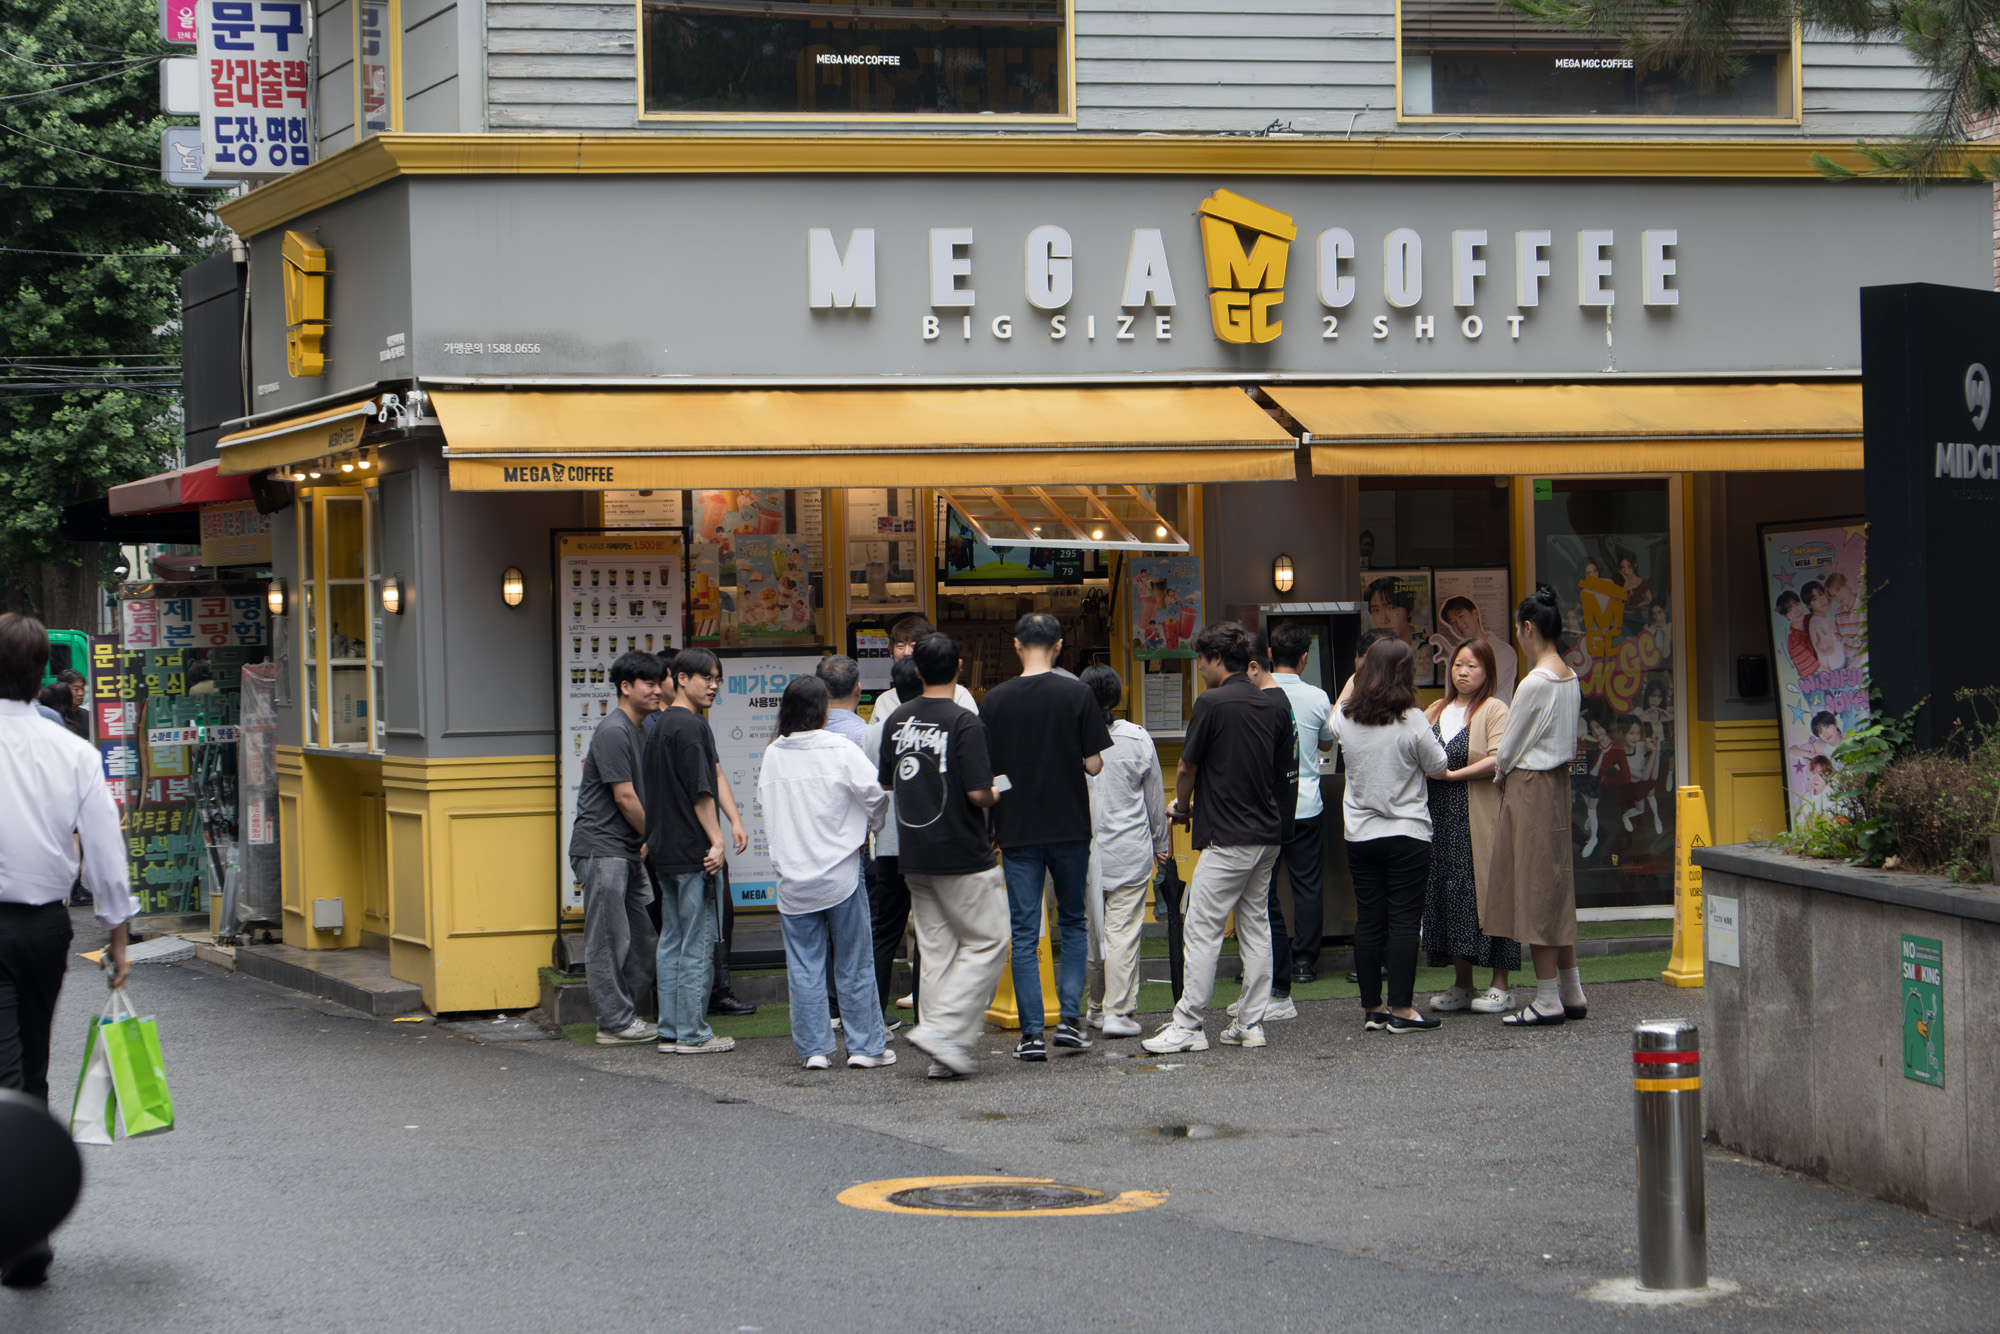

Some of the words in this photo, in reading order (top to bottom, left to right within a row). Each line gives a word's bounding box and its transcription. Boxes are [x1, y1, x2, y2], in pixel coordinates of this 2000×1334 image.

[212, 2, 303, 51] 문구
[816, 54, 843, 64] MEGA
[844, 54, 865, 65] MGC
[865, 55, 900, 66] COFFEE
[1555, 58, 1581, 68] MEGA
[1581, 58, 1600, 68] MGC
[1601, 58, 1634, 69] COFFEE
[211, 59, 306, 109] 칼라출력
[808, 224, 1176, 310] MEGA
[1316, 227, 1679, 308] COFFEE
[443, 343, 484, 354] 가맹문의
[486, 343, 541, 354] 1588.0656
[1935, 442, 2000, 479] MIDCI
[504, 467, 550, 482] MEGA
[569, 467, 613, 482] COFFEE
[1060, 549, 1077, 558] 295
[1794, 558, 1811, 567] MEGA
[1062, 567, 1074, 576] 79
[728, 674, 804, 695] 메가오
[150, 730, 180, 742] 스마트폰
[182, 729, 198, 741] 출력
[742, 889, 767, 900] MEGA
[1713, 915, 1723, 923] CCTV
[1903, 940, 1916, 959] NO
[1903, 961, 1940, 986] SMOKING
